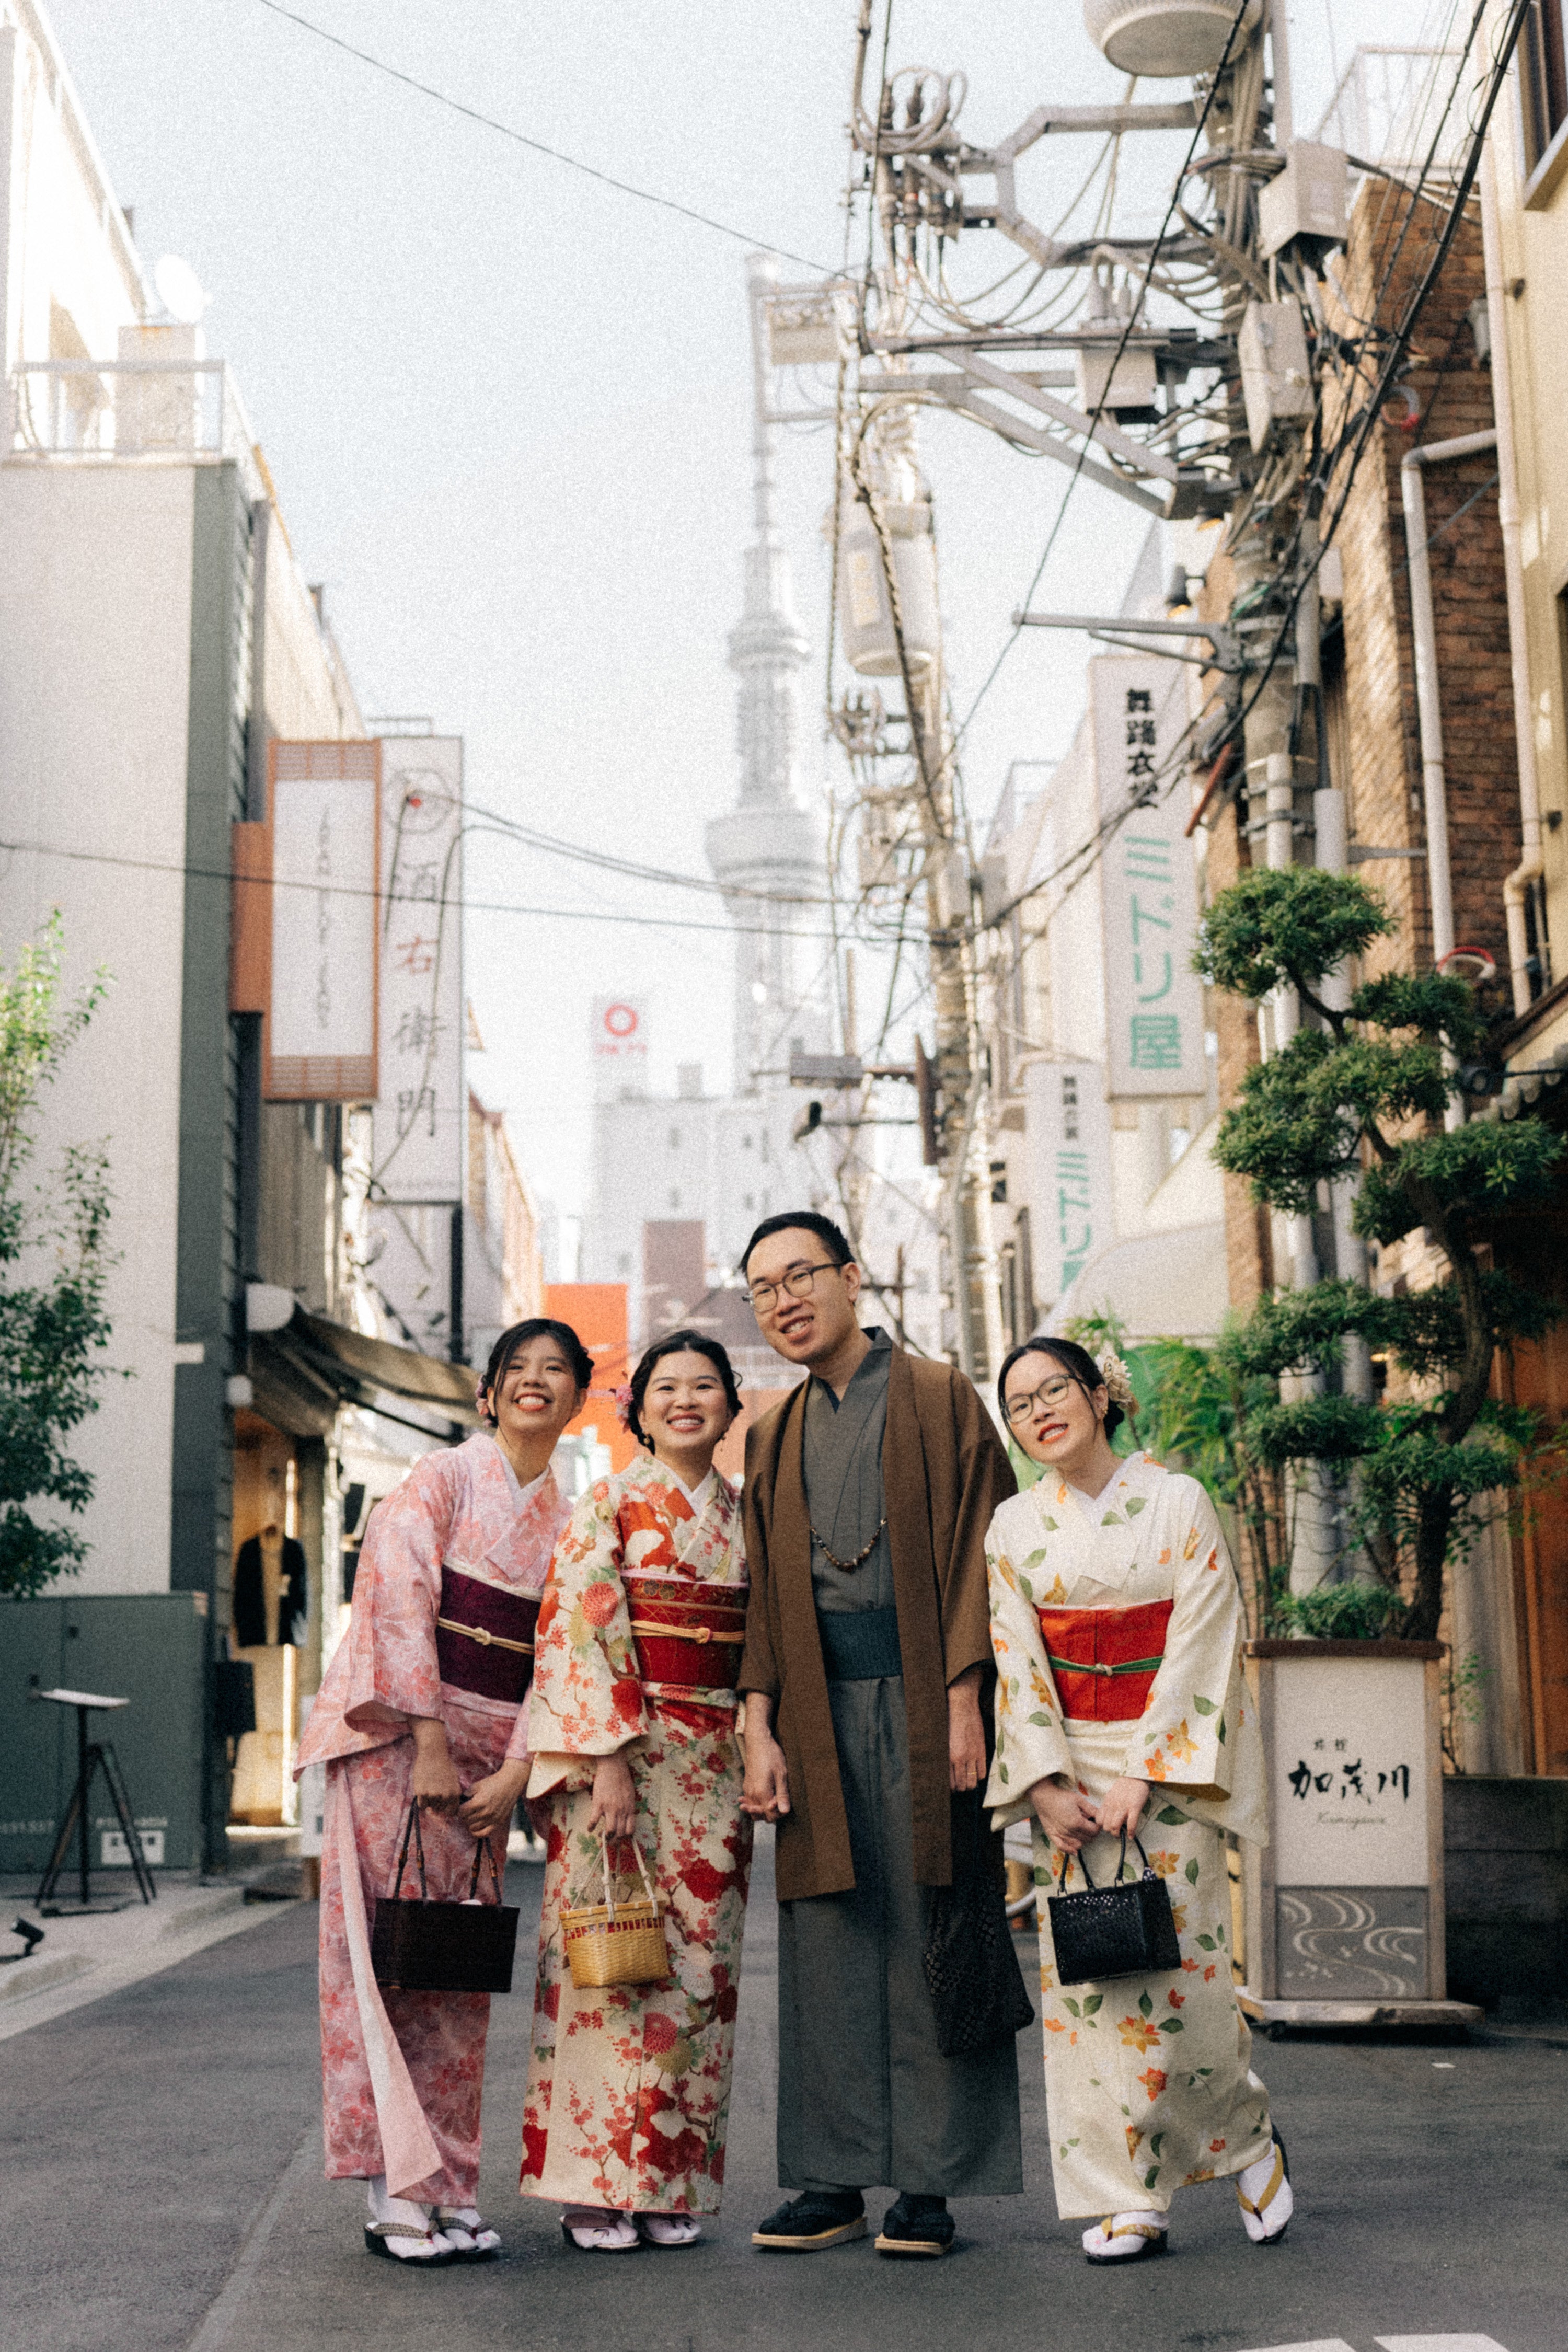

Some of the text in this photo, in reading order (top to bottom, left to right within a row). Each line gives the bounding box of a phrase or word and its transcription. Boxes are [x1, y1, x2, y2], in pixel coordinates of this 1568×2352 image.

[1124, 835, 1182, 1070] ミドリ屋
[1287, 1758, 1410, 1804] 加茂川
